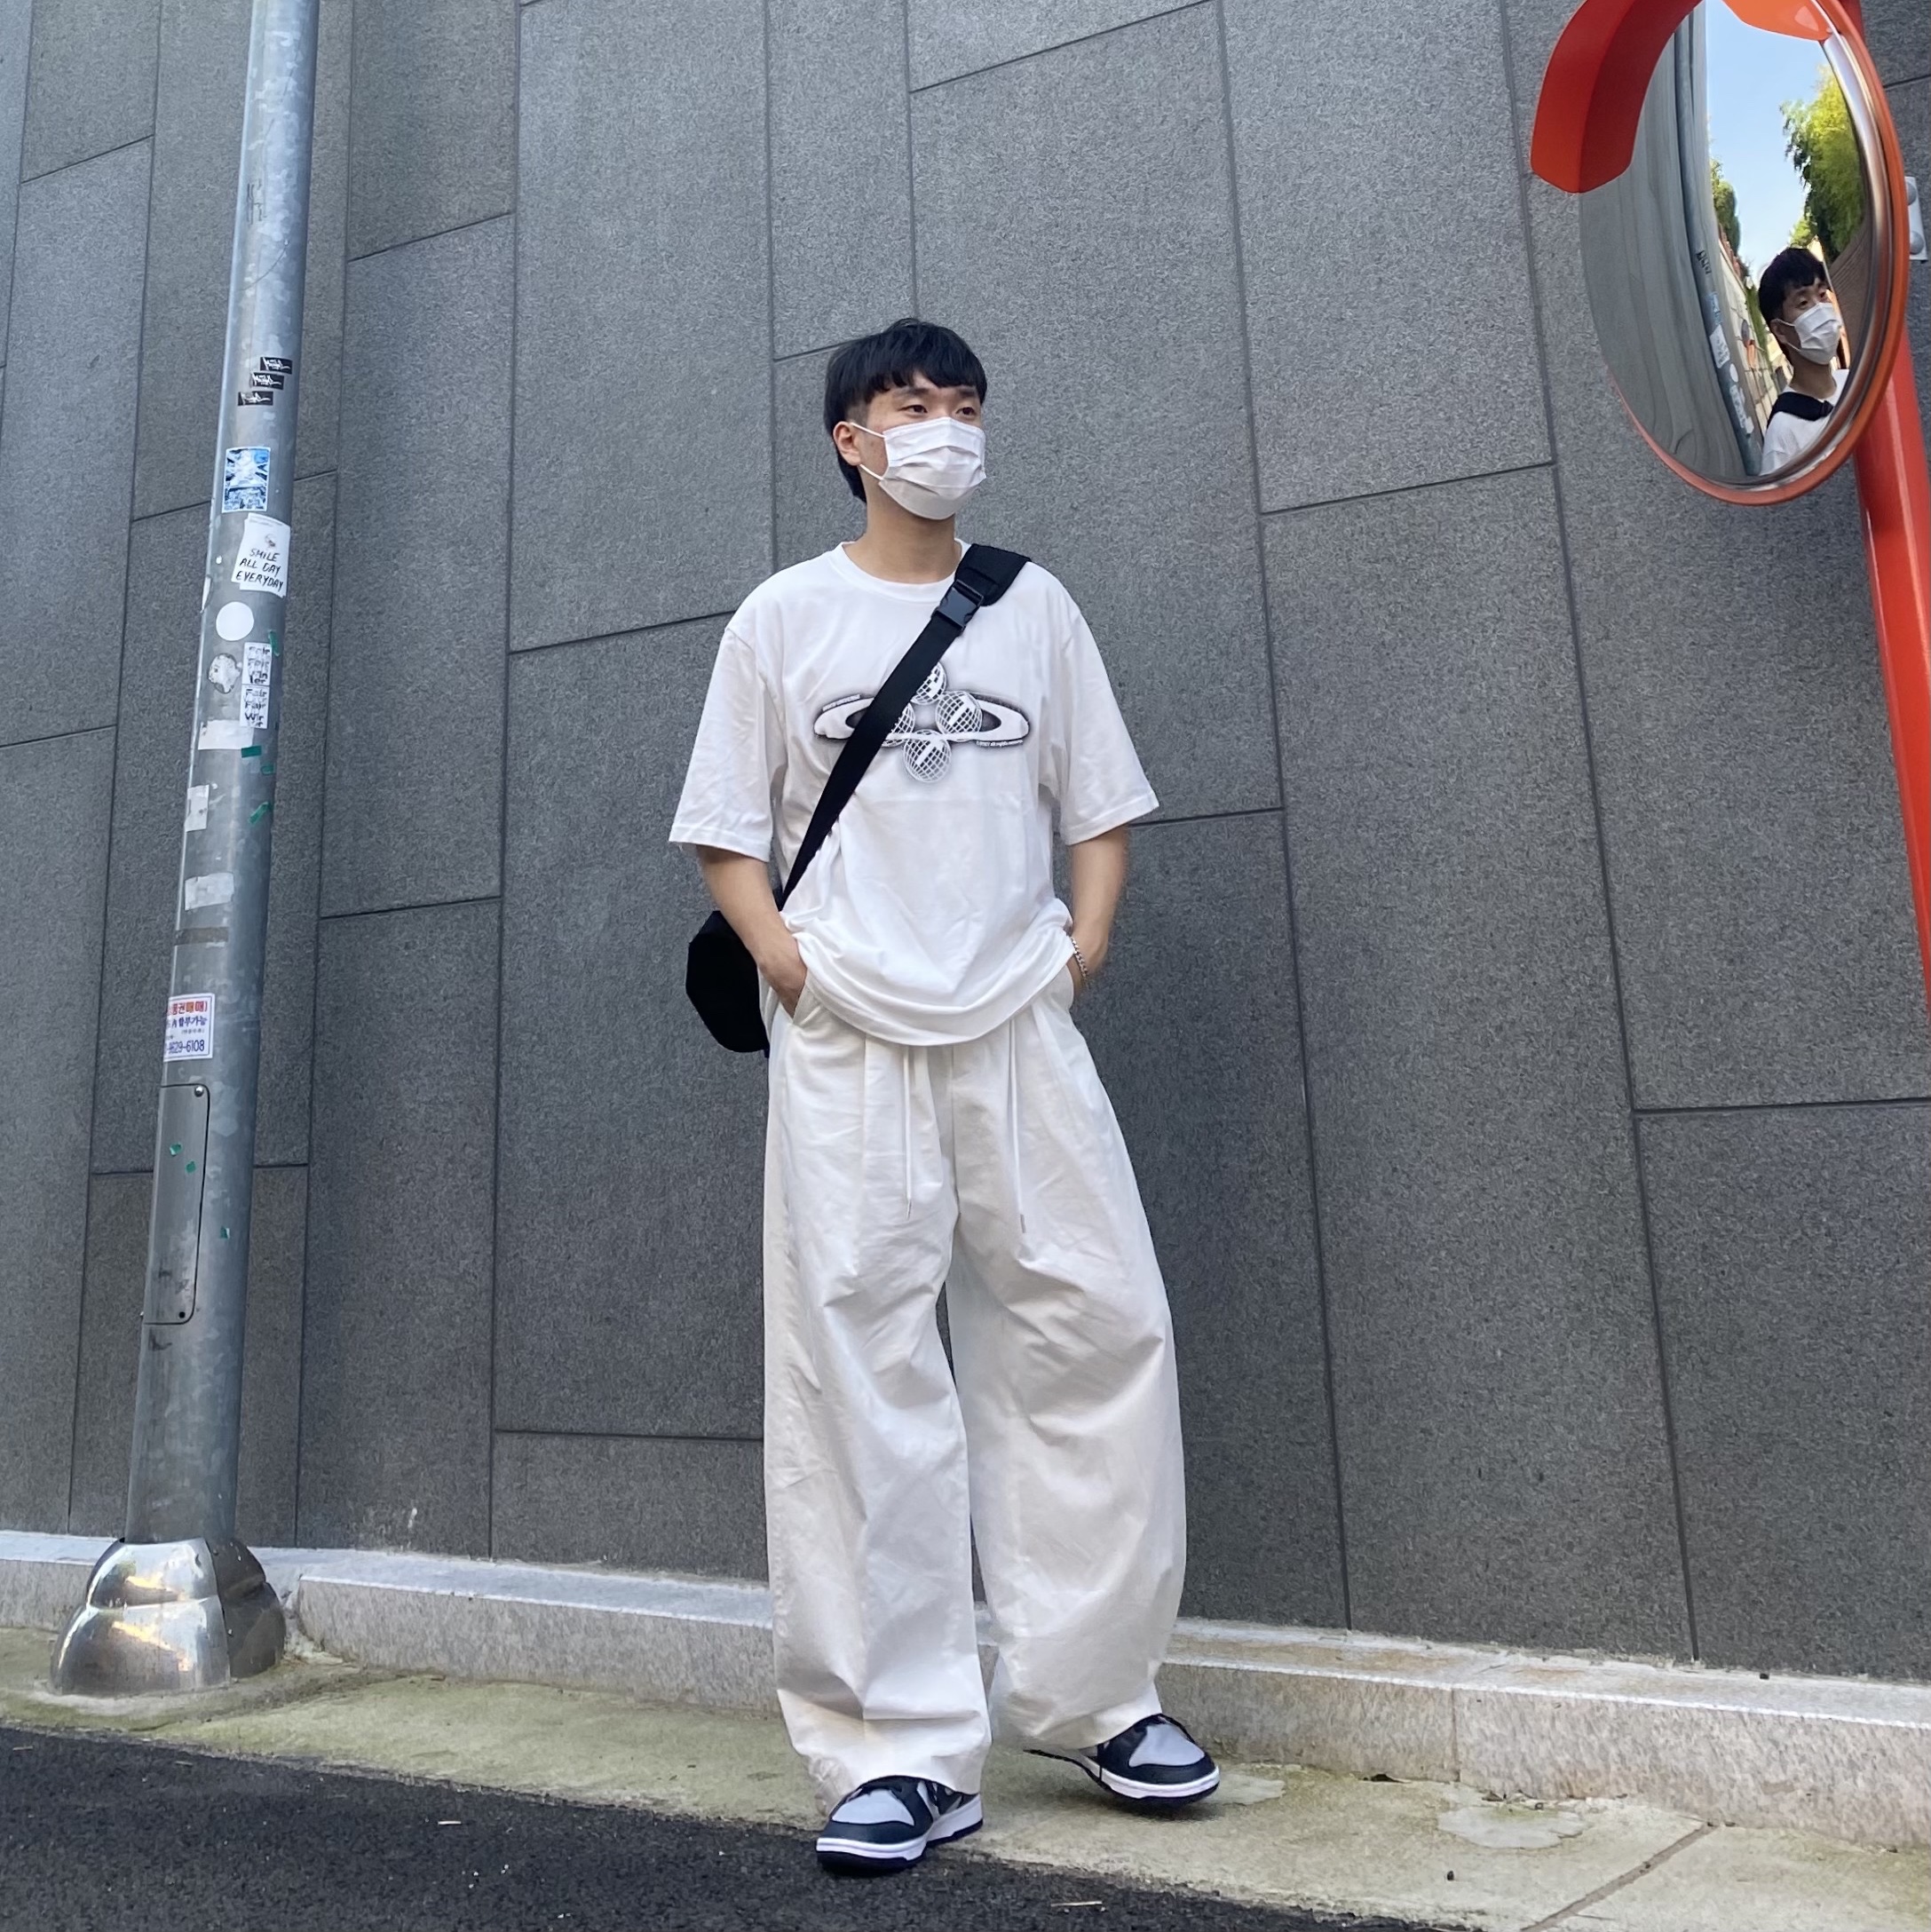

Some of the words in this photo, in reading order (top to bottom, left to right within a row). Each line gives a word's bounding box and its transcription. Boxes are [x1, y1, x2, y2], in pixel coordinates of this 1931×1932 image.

[249, 548, 281, 562] SMILE
[239, 558, 257, 569] ALL
[235, 571, 284, 592] EVERYDAY
